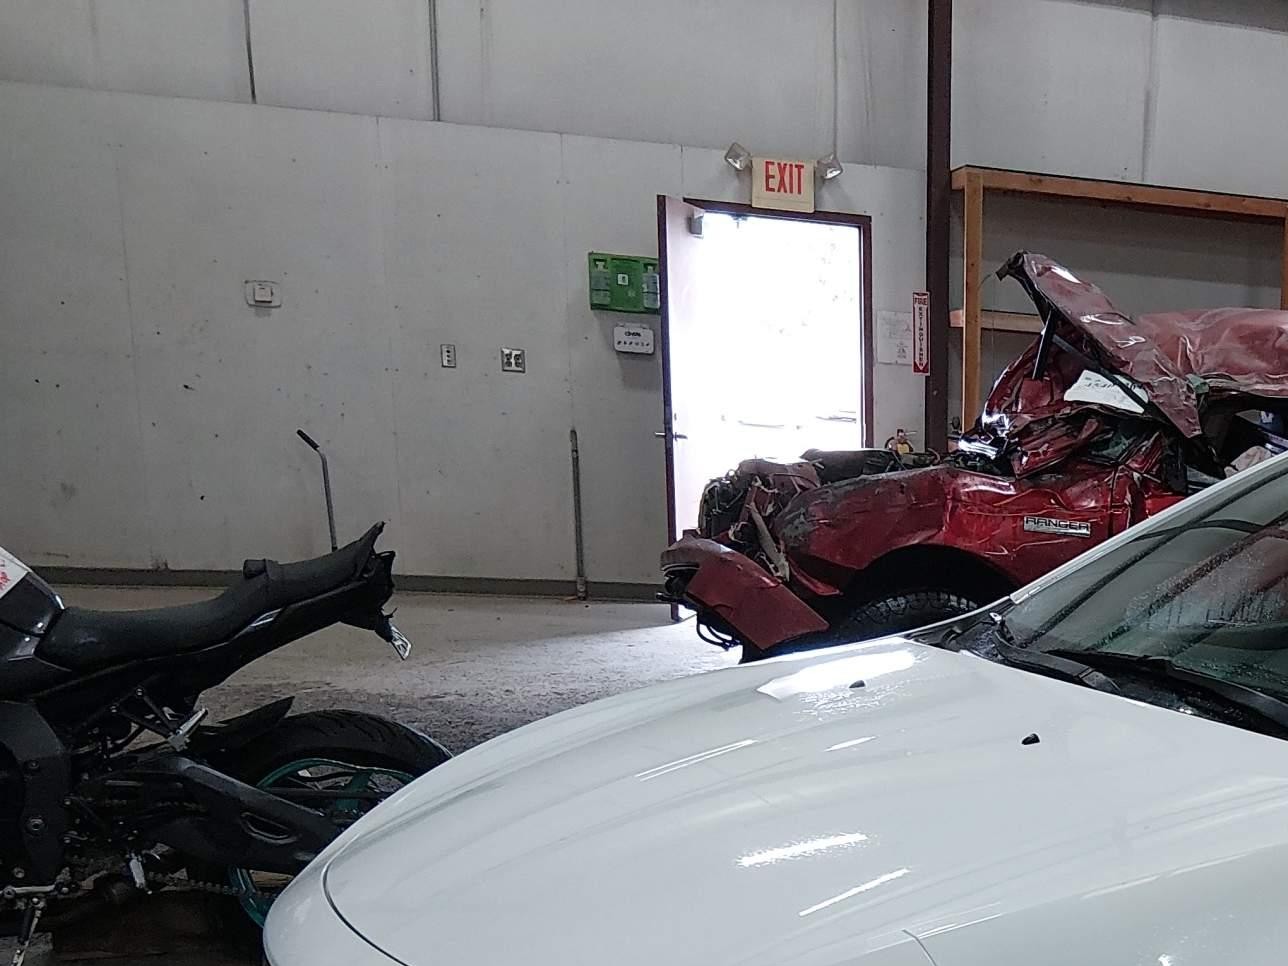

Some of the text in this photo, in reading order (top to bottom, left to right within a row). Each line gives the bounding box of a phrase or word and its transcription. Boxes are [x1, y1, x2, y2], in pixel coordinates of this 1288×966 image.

[765, 161, 805, 195] EXIT
[914, 298, 928, 306] FIRE
[1025, 516, 1089, 532] RANGER
